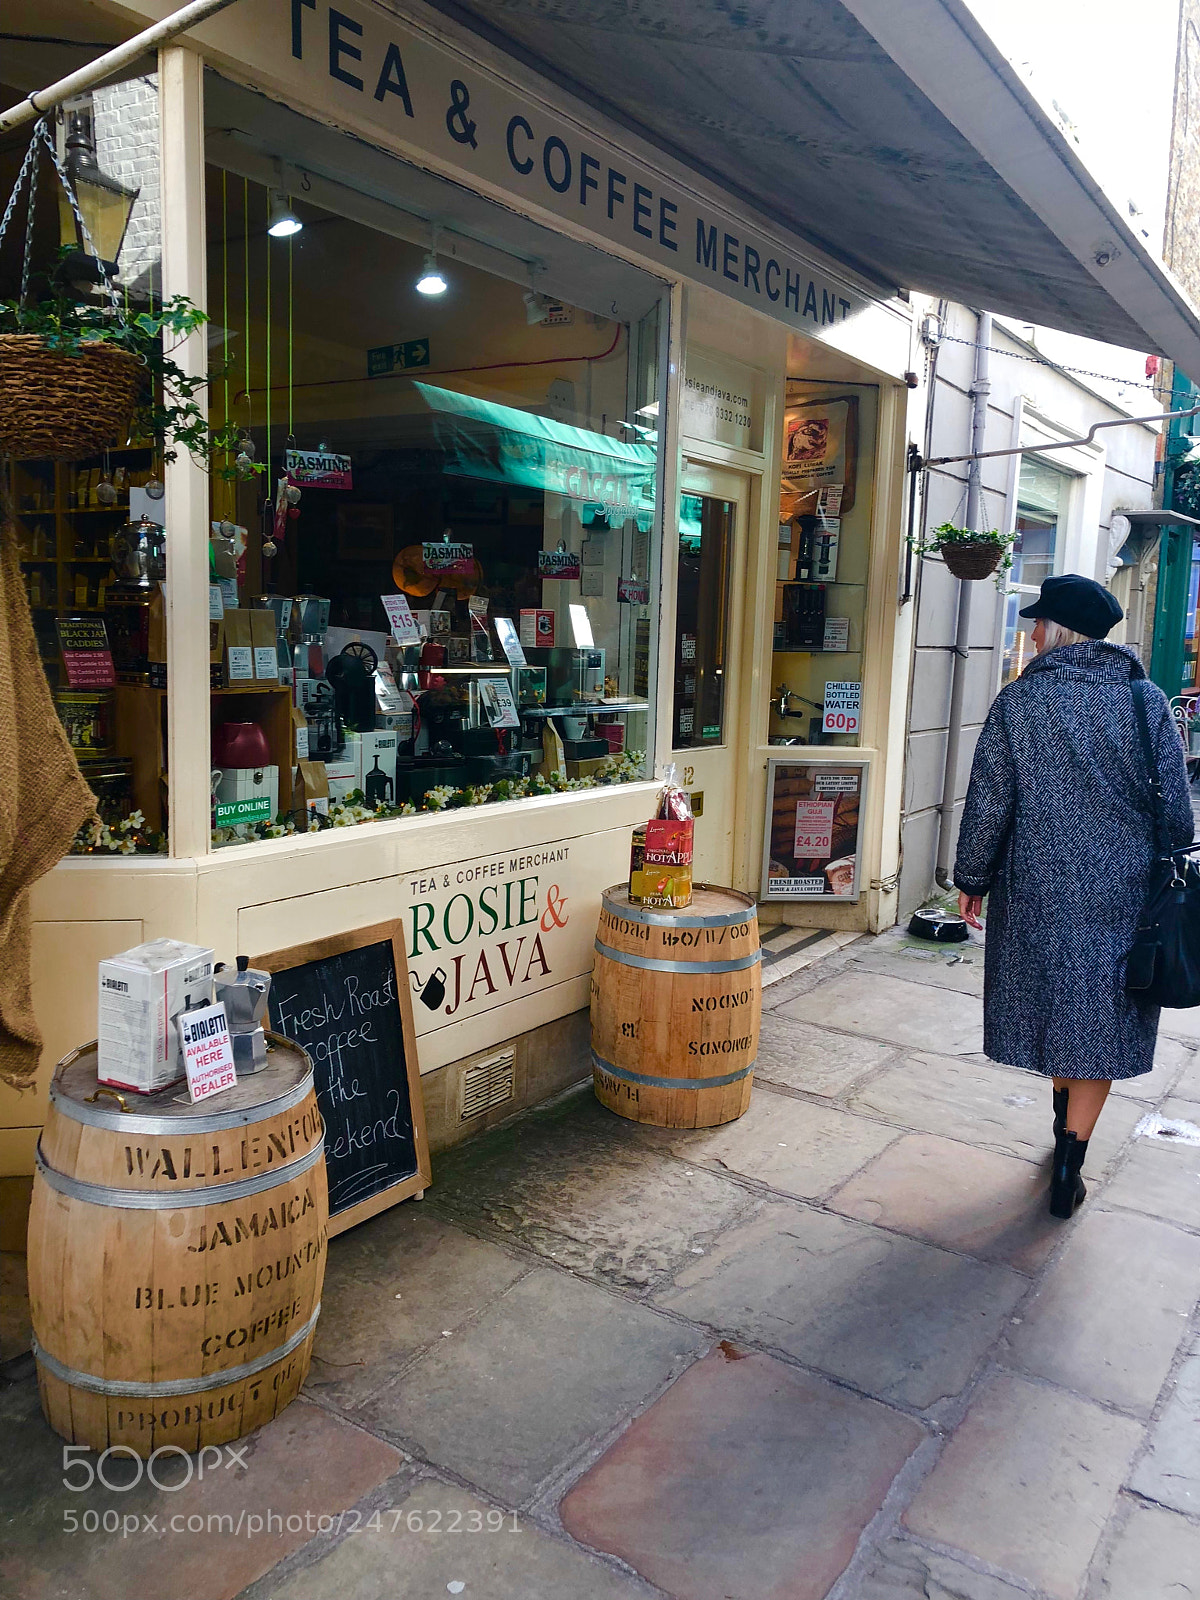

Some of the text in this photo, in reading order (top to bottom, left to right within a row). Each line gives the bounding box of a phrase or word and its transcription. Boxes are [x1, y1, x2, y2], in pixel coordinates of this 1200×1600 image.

[291, 0, 851, 326] TEA & COFFEE MERCHANT
[716, 406, 733, 422] 8332
[288, 455, 351, 473] JASMINE
[565, 465, 630, 507] GAGGIA
[424, 547, 473, 560] JASMINE
[539, 554, 580, 567] JASMINE
[391, 613, 413, 629] £15
[60, 630, 89, 638] BLACK
[66, 639, 105, 648] CADDIES
[682, 648, 696, 659] WEEK
[826, 682, 861, 691] CHILLED
[826, 691, 860, 699] BOTTLED
[497, 698, 512, 708] £39
[825, 700, 860, 710] WATER
[680, 722, 693, 733] WEEK
[825, 713, 857, 732] 60p
[683, 766, 695, 786] 12
[217, 800, 270, 817] BUY ONLINE
[796, 835, 829, 847] £4.20
[410, 847, 570, 896] TEA & COFFEE MERCHANT
[793, 878, 825, 886] ROASTED
[407, 875, 570, 959] ROSIE &
[445, 932, 552, 1016] JAVA
[106, 977, 129, 993] BIALETTI
[277, 967, 396, 1037] Fresh Roast
[692, 988, 755, 1013] LONDON
[190, 1013, 227, 1043] BIALETTI
[186, 1034, 229, 1058] AVAILABLE
[688, 1034, 753, 1056] EDMONDS
[195, 1048, 224, 1069] HERE
[191, 1062, 233, 1085] AUTHORISED
[194, 1074, 235, 1098] DEALER
[327, 1076, 368, 1109] the
[187, 1187, 315, 1253] JAMAICA
[135, 1281, 219, 1310] BLUE
[201, 1296, 302, 1358] COFFEE
[117, 1379, 263, 1431] PRODUCT
